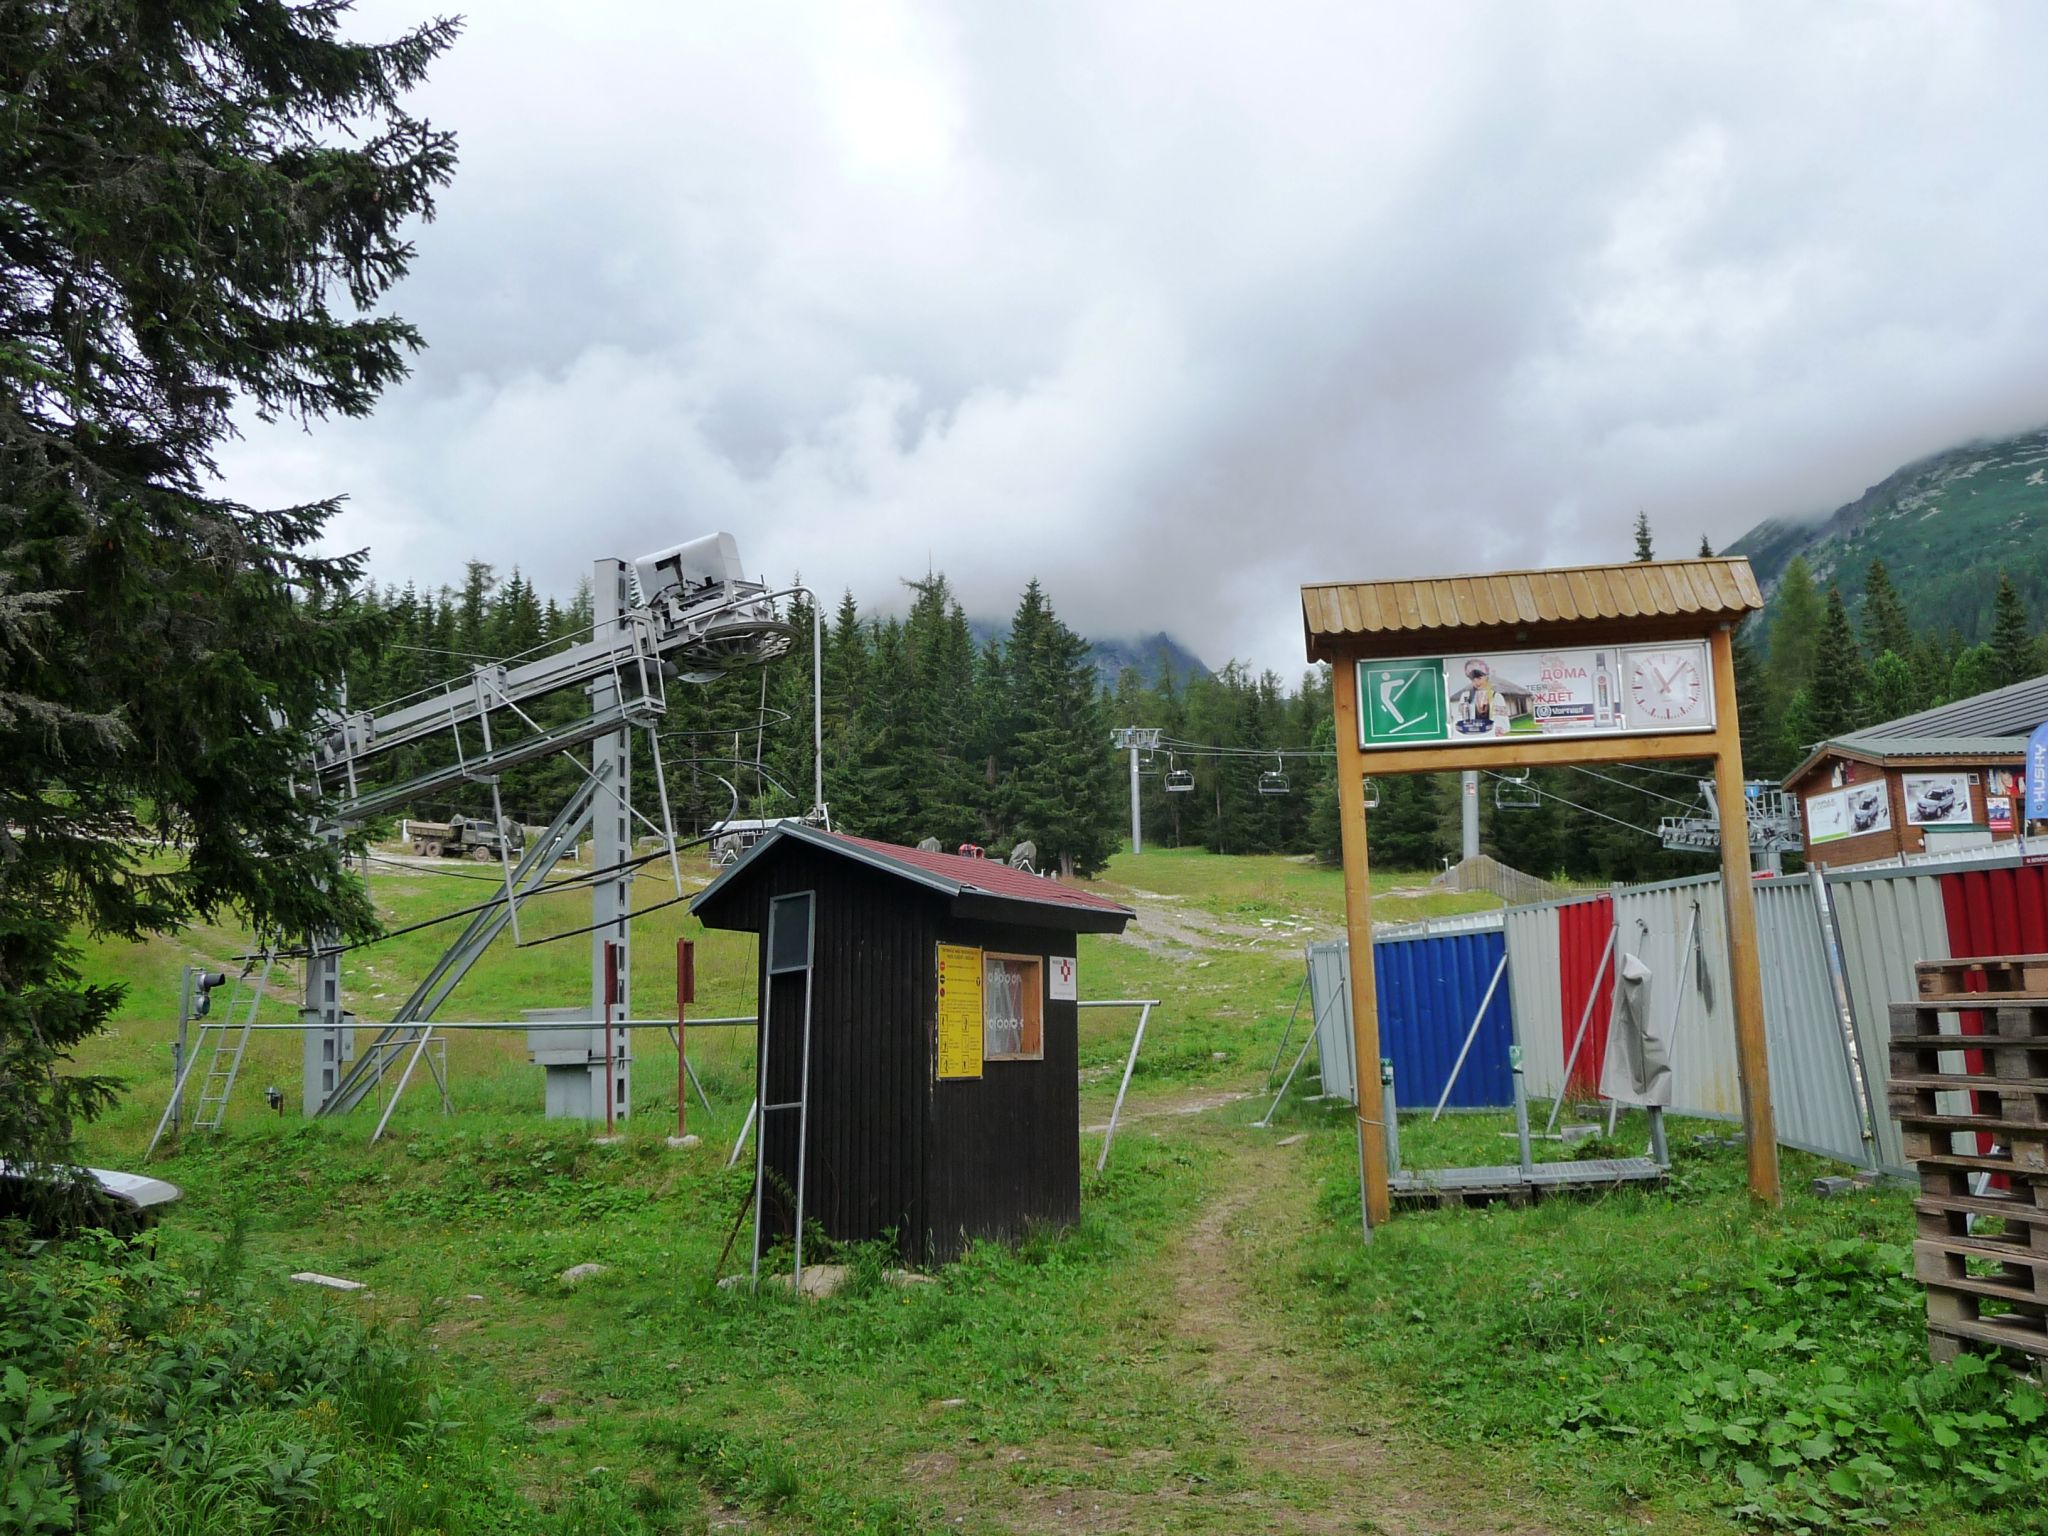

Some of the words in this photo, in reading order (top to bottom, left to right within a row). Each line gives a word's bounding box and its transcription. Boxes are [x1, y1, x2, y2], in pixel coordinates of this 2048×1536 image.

[1541, 667, 1587, 681] ДОМА
[1526, 684, 1548, 692] ТЕБЯ
[1534, 691, 1574, 703] ЖДЕТ
[2033, 744, 2046, 802] HUSKY
